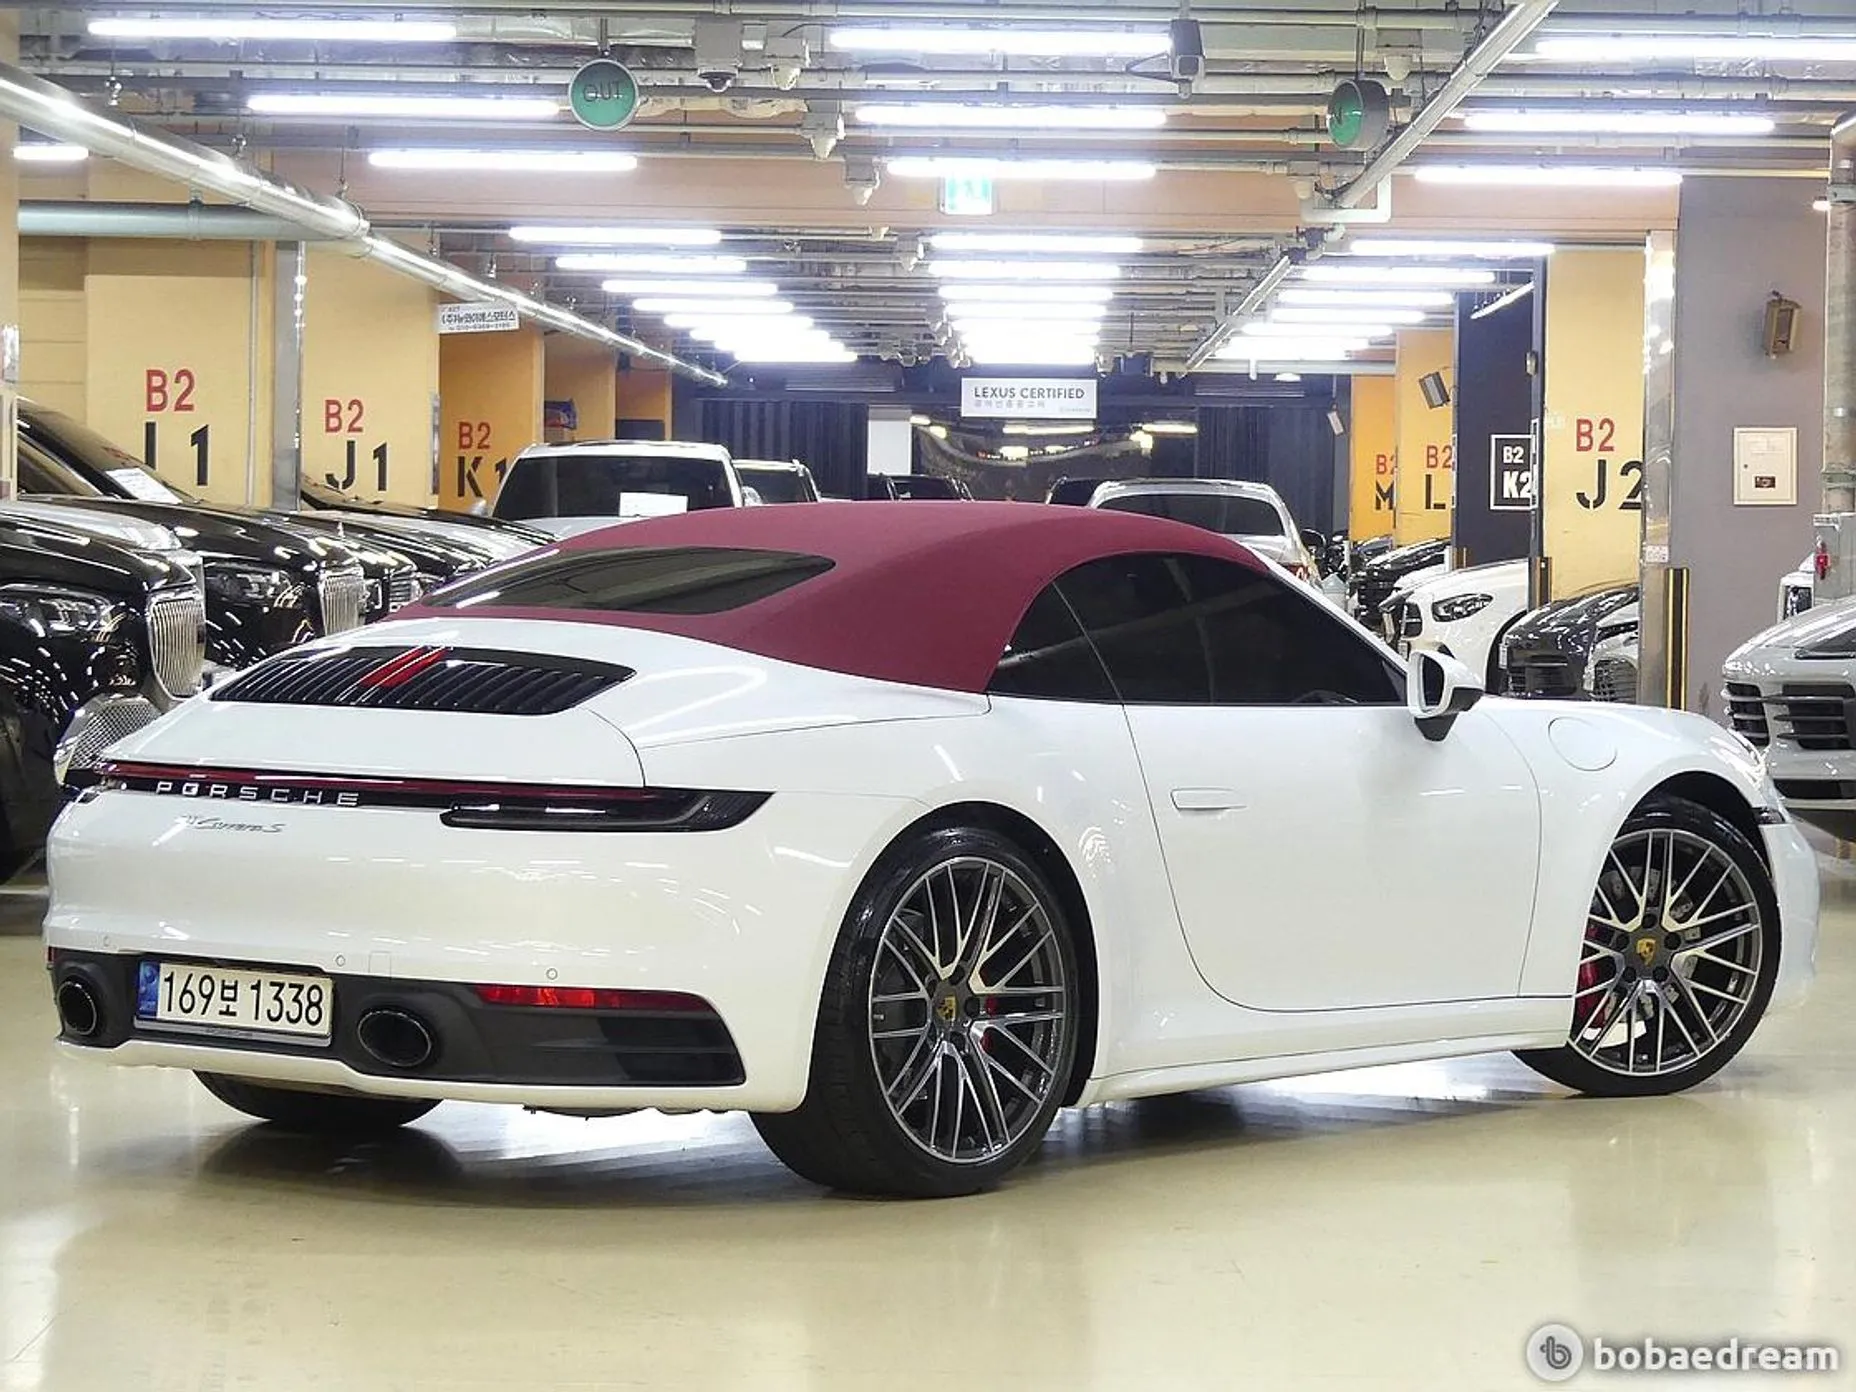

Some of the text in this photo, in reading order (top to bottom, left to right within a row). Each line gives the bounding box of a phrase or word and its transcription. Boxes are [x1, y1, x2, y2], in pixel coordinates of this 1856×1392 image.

[583, 81, 623, 102] OUT
[145, 368, 195, 412] B2
[974, 386, 1085, 399] LEXUS CERTIFIED
[325, 399, 364, 433] B2
[458, 421, 491, 450] B2
[1575, 417, 1615, 452] B2
[325, 440, 387, 490] J1
[1426, 445, 1453, 468] B2
[1503, 446, 1525, 464] B2
[1375, 481, 1395, 510] M
[1425, 474, 1446, 510] L
[1503, 471, 1532, 499] K2
[1576, 459, 1644, 510] J2
[156, 781, 360, 807] PORSCHE
[163, 971, 323, 1026] 169보 1338
